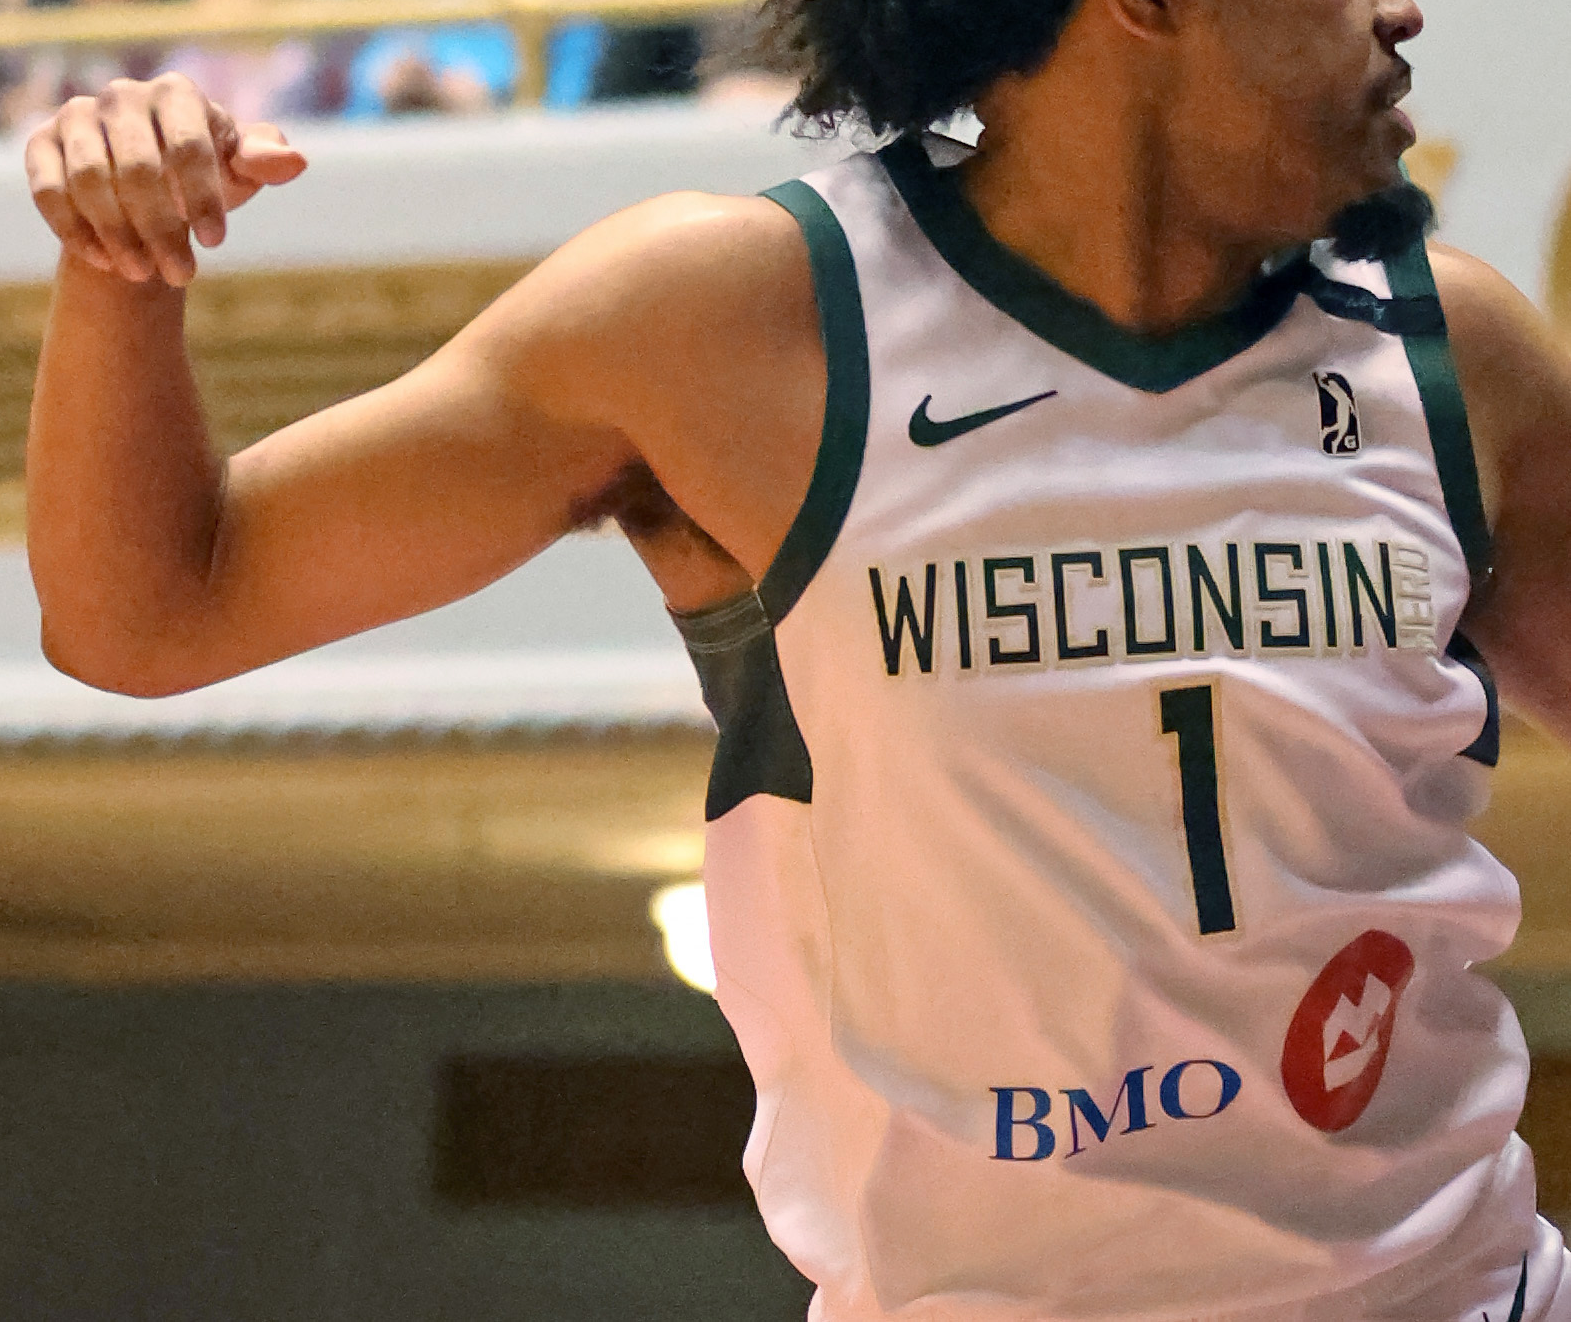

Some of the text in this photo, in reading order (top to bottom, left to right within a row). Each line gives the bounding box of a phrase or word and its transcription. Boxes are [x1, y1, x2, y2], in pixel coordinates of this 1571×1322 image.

[867, 537, 1400, 677] WISCONSIN
[1157, 682, 1237, 937] 1
[986, 1057, 1242, 1163] BMO
